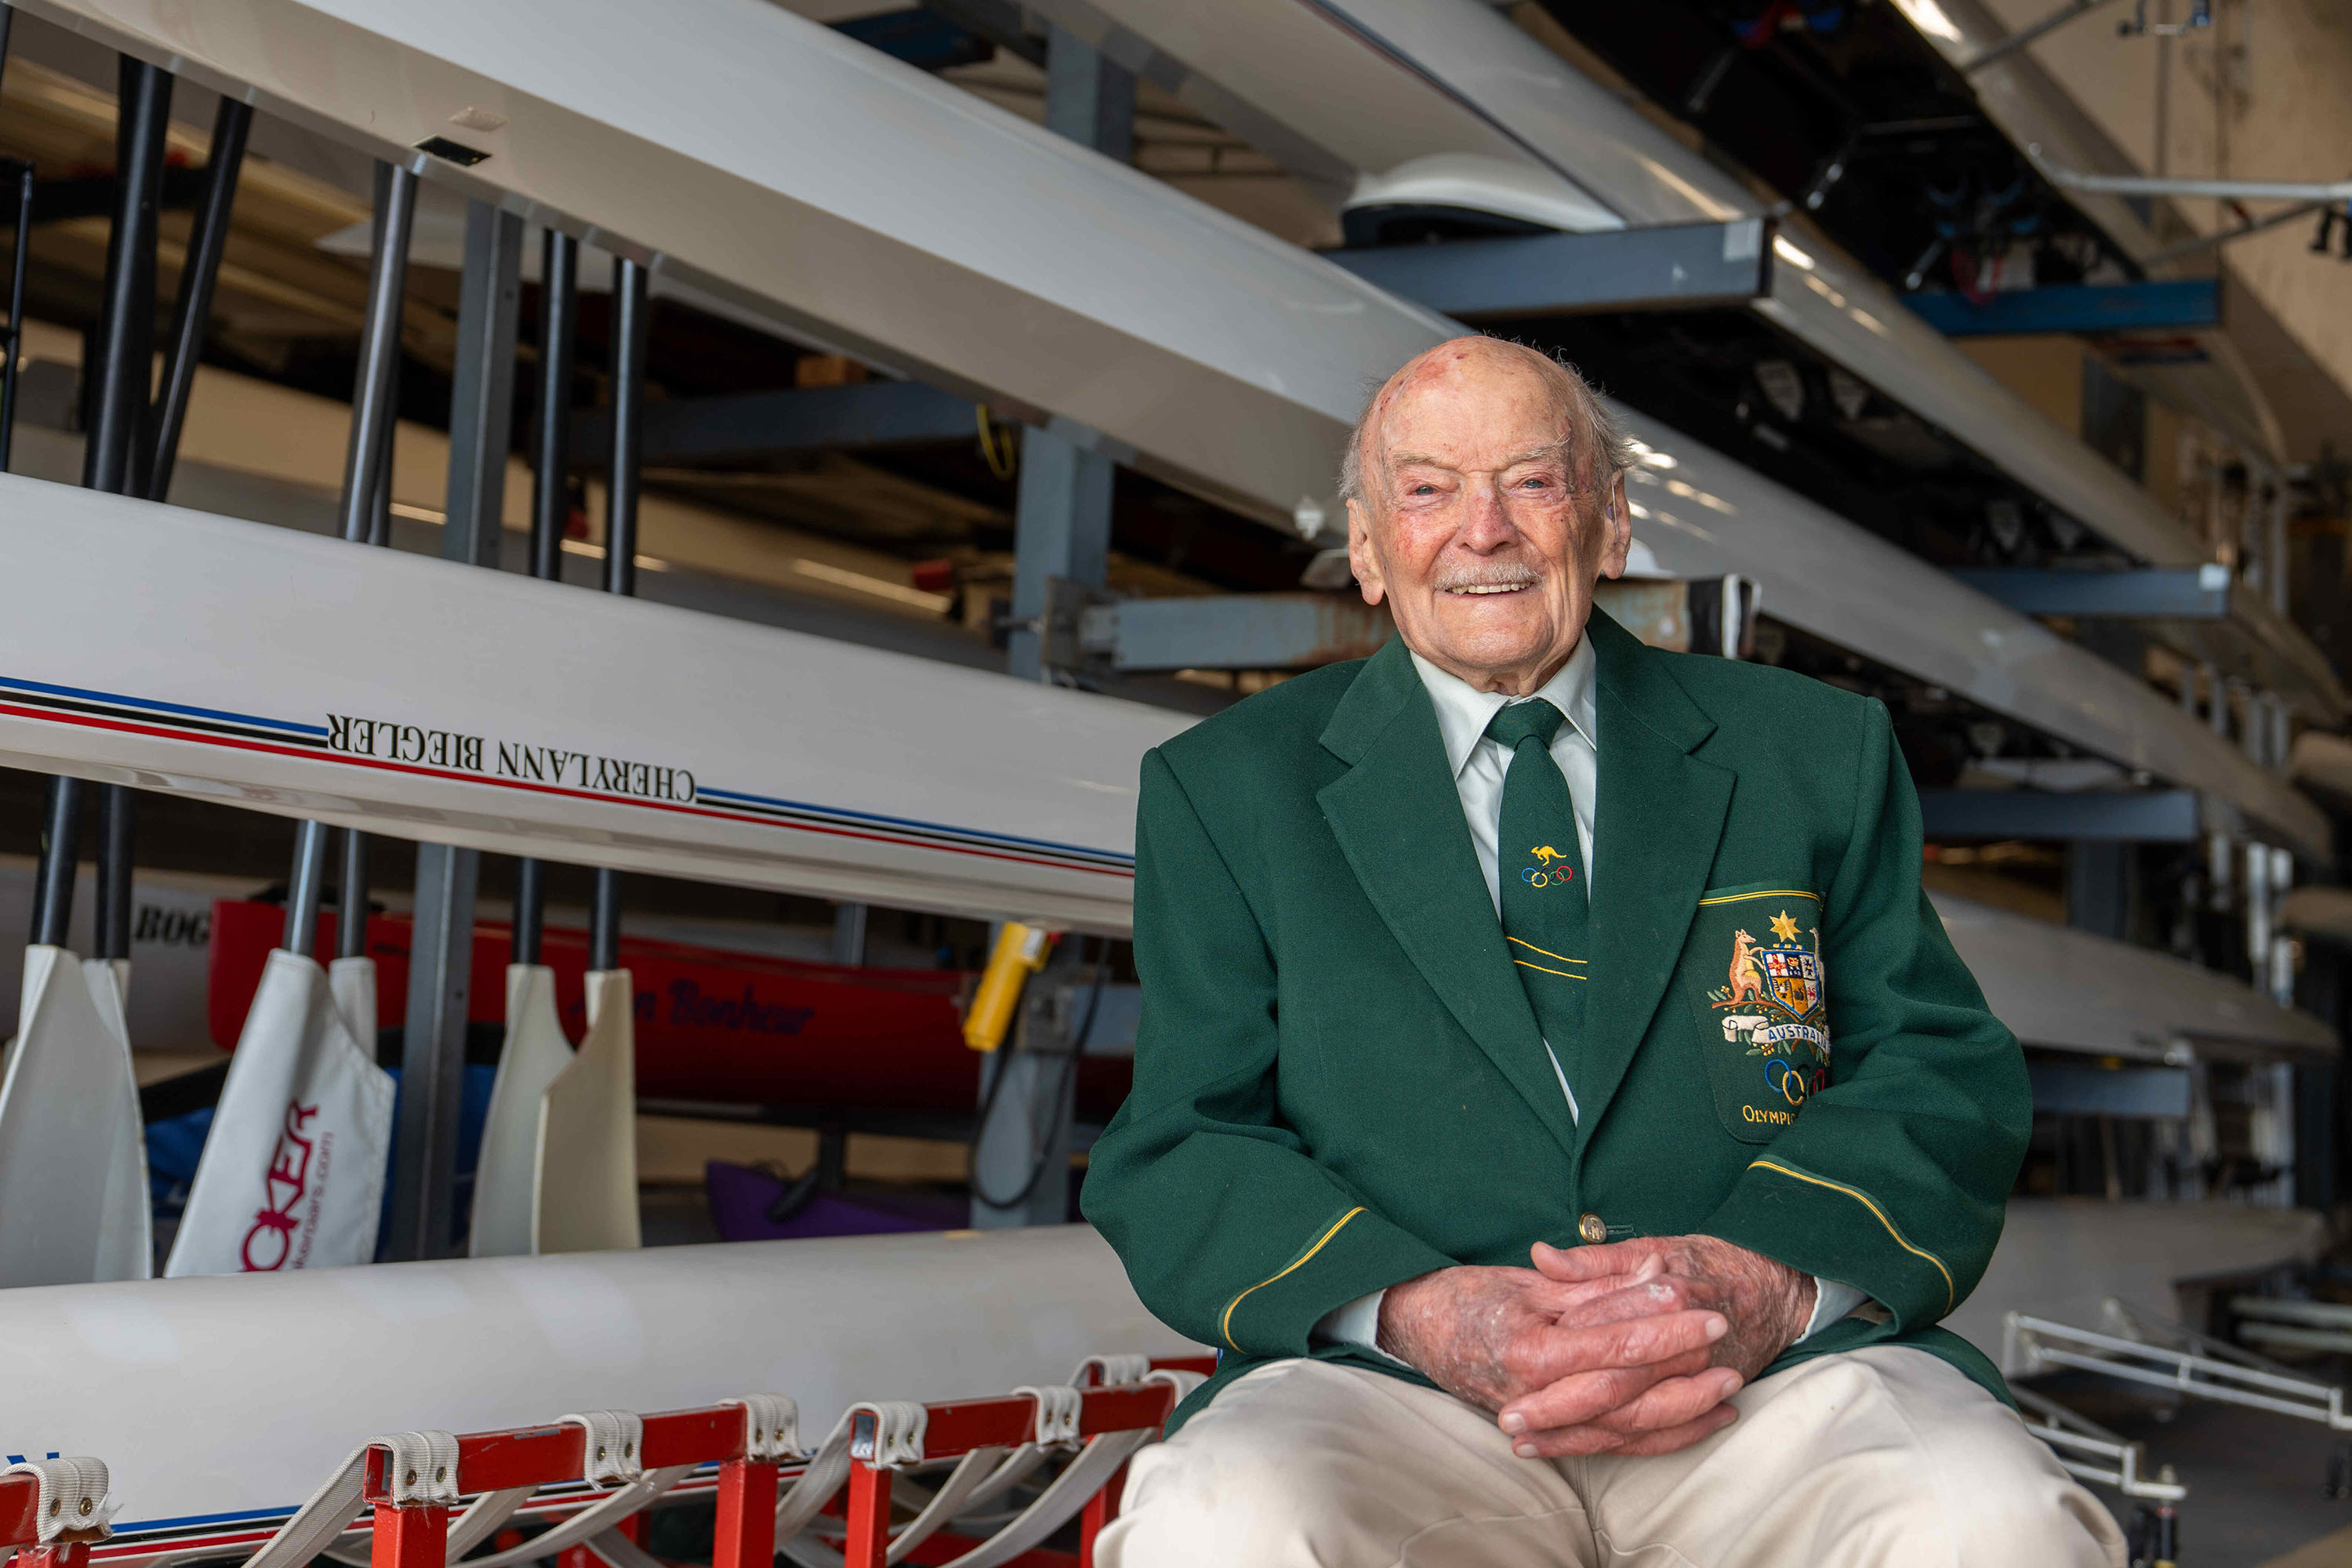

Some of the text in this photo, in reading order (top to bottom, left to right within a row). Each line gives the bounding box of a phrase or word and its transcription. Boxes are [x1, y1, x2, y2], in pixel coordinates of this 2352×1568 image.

[326, 713, 696, 803] CHERYLANN BIEGLER
[1768, 1025, 1828, 1051] AUSTRALIA
[238, 1099, 318, 1272] OKER
